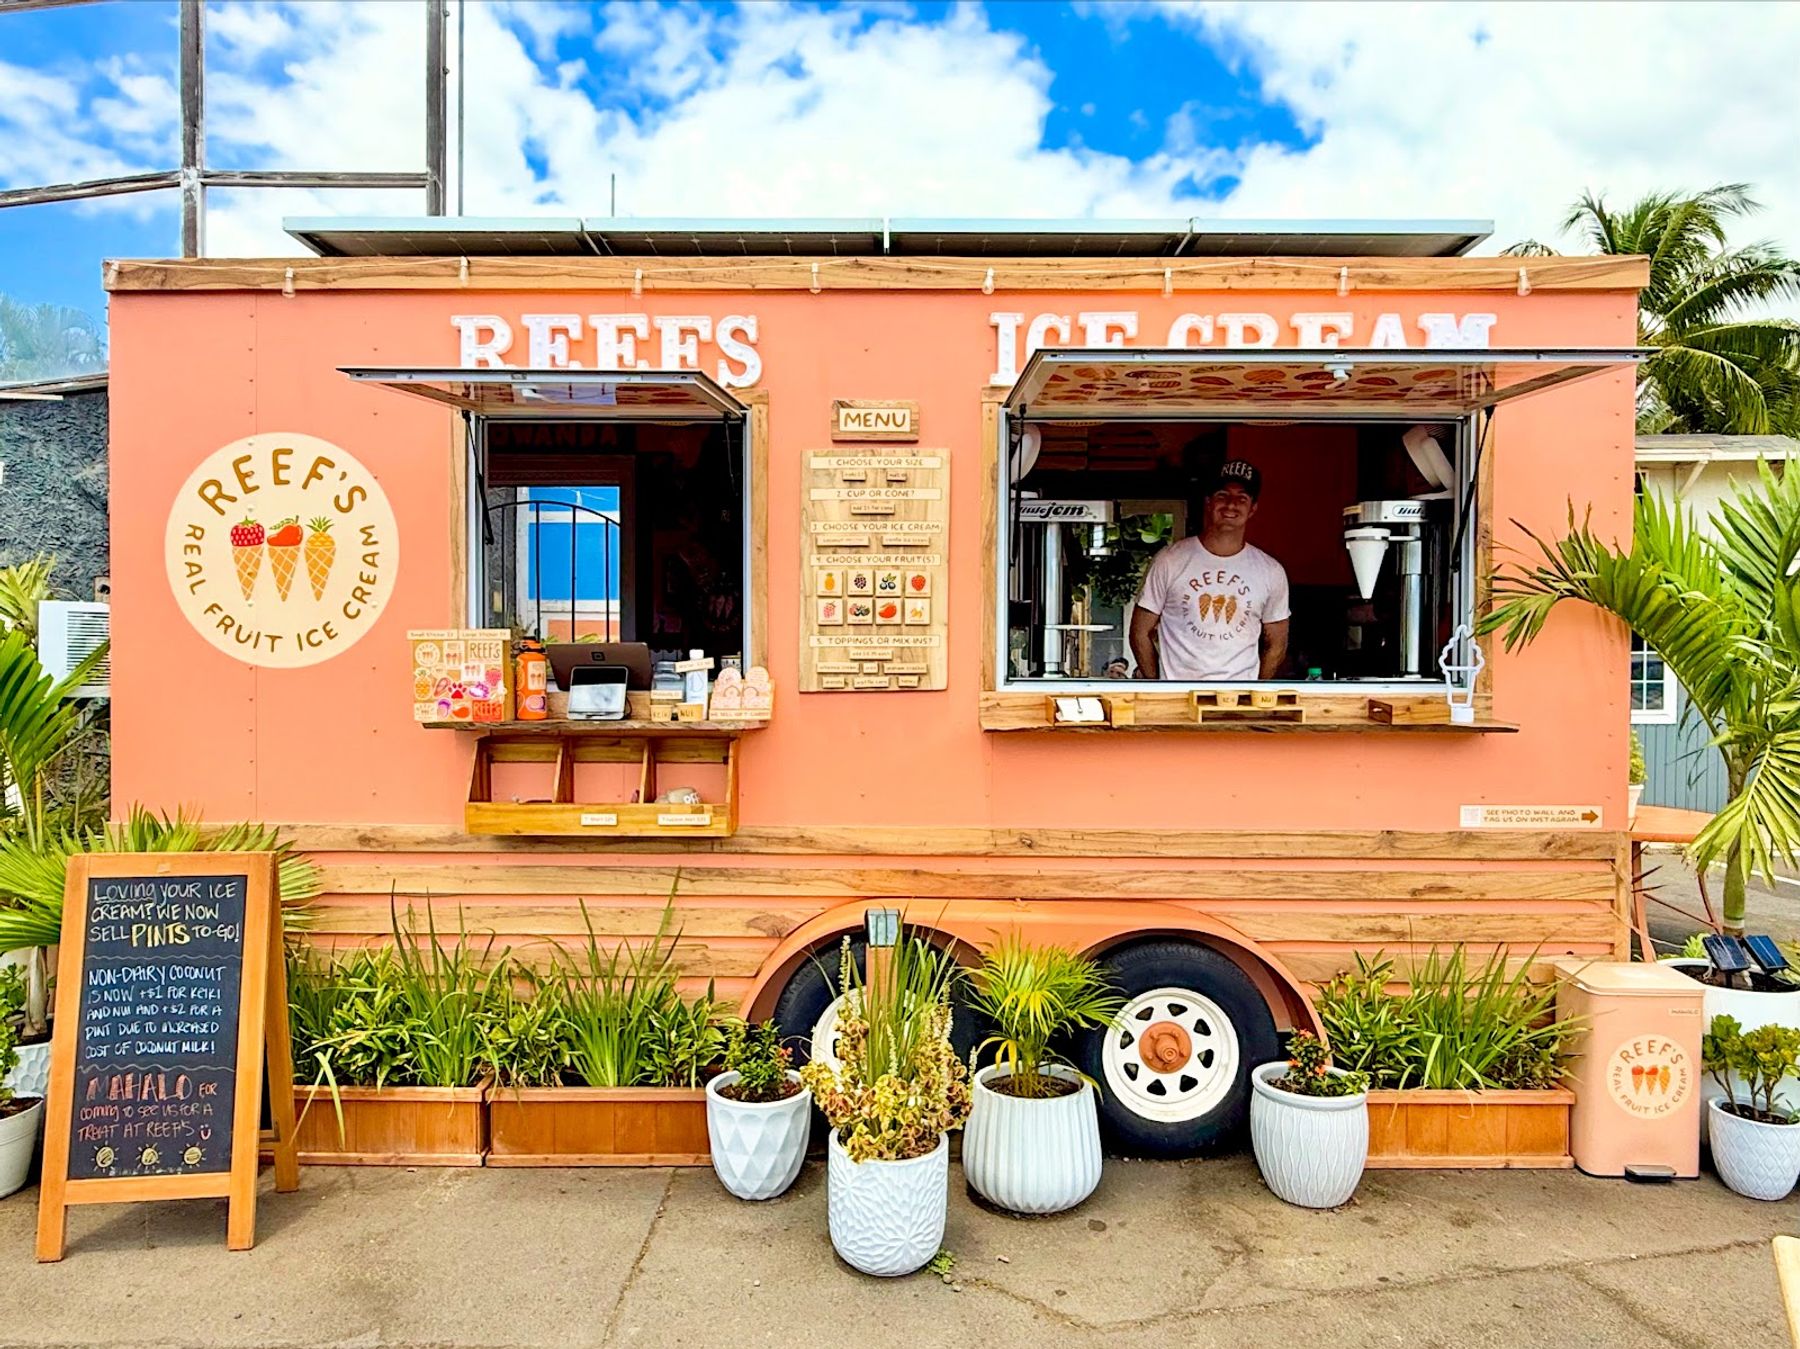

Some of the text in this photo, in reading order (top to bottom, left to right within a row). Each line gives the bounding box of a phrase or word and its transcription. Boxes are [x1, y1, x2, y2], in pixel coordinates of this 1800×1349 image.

[451, 314, 762, 388] REEFS
[844, 412, 906, 427] MENU
[836, 458, 872, 466] CHOOSE
[877, 458, 902, 466] YOUR
[905, 458, 923, 466] SIZE
[198, 448, 367, 516] REEF'S
[847, 490, 866, 498] CUP
[869, 490, 881, 498] OR
[885, 490, 915, 498] CONE?
[822, 523, 858, 531] CHOOSE
[862, 523, 887, 531] YOUR
[890, 523, 903, 531] ICE
[907, 523, 940, 531] CREAM
[826, 556, 862, 564] CHOOSE
[866, 556, 891, 564] YOUR
[894, 556, 936, 564] FRUIT(S)
[183, 523, 380, 652] REAL FRUIT ICE CREAM
[1189, 570, 1251, 596] REEF'S
[1187, 621, 1215, 640] FRUIT
[1219, 631, 1234, 640] ICE
[828, 637, 873, 645] TOPPINGS
[876, 637, 889, 645] OR
[892, 637, 910, 645] MIX
[912, 637, 933, 645] INS?
[208, 882, 238, 899] ICE
[91, 903, 220, 923] CREAM? WE NOW
[88, 925, 130, 942] SELL
[131, 922, 191, 948] PINTS
[88, 965, 227, 986] NON-DAIRY COCONUT
[87, 990, 101, 1004] IS
[104, 986, 134, 1002] NOW
[167, 986, 187, 998] FOR
[86, 1006, 112, 1020] AND
[136, 1004, 159, 1016] AND
[190, 1004, 208, 1016] FOR
[211, 1004, 222, 1016] A
[85, 1024, 111, 1041] PINT
[118, 1021, 141, 1036] DUE
[144, 1021, 157, 1033] TO
[85, 1040, 216, 1059] COST OF COCONUT MILK!
[1619, 1039, 1684, 1065] REEF'S
[86, 1072, 219, 1102] MAHALO FOR
[1613, 1066, 1687, 1114] REAL FRUIT ICE CREAM
[202, 1103, 214, 1116] A
[77, 1123, 120, 1142] TREAT
[123, 1122, 145, 1138] AT
